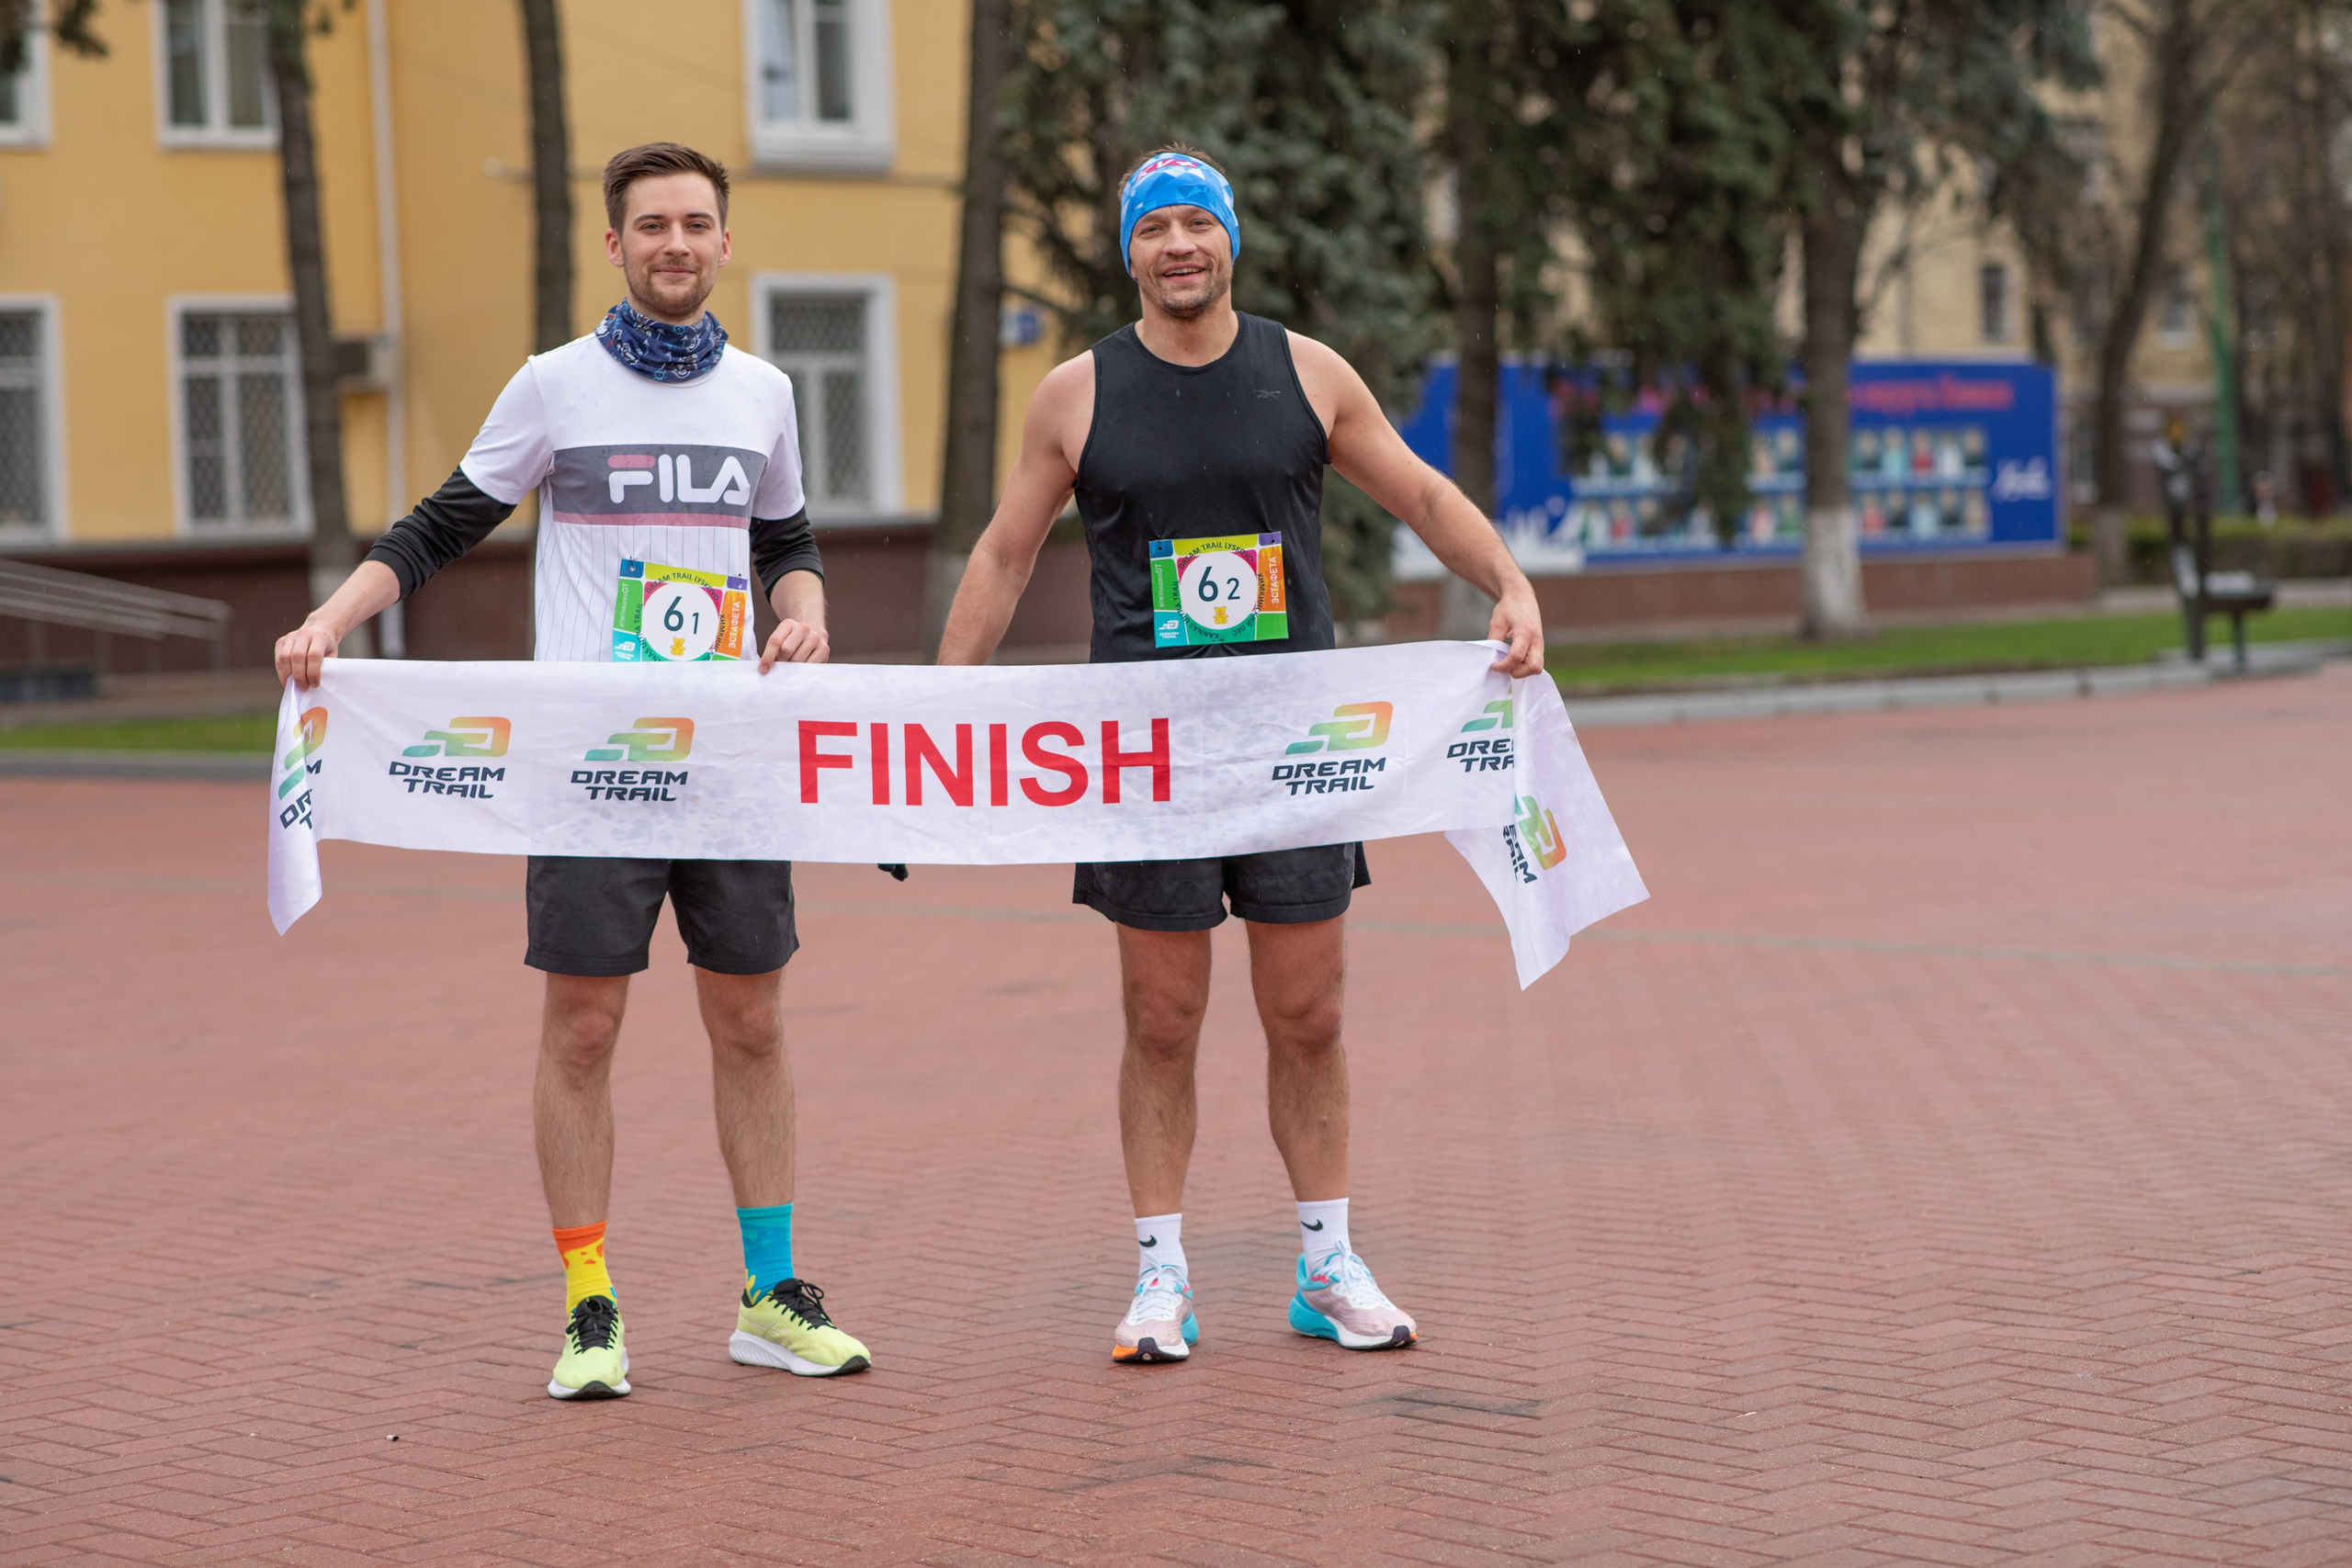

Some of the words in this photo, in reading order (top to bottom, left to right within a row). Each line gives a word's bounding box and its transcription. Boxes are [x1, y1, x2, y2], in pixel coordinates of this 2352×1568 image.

[607, 454, 751, 506] FILA
[1179, 547, 1201, 570] DREAM
[1201, 542, 1223, 550] TRAIL
[1225, 542, 1254, 562] LYSKOVO
[645, 574, 671, 593] DREAM
[672, 572, 693, 581] TRAIL
[694, 576, 719, 602] LYSKOVO
[1198, 566, 1218, 602] 6
[1227, 578, 1240, 600] 2
[1269, 557, 1279, 604] ЭСТАФЕТА
[634, 604, 643, 624] TRAIL
[663, 595, 684, 631] 6
[692, 612, 699, 635] 1
[729, 602, 741, 649] ЭСТАФЕТА
[1189, 623, 1219, 638] KANNAS
[1232, 625, 1246, 636] ЛЕС
[1446, 738, 1514, 759] DRE
[389, 761, 505, 782] DREAM
[798, 717, 1170, 807] FINISH
[1272, 757, 1386, 781] DREAM
[1459, 754, 1514, 773] TRA
[402, 778, 494, 798] TRAIL
[571, 770, 688, 785] DREAM
[1285, 776, 1374, 795] TRAIL
[585, 785, 676, 802] TRAIL
